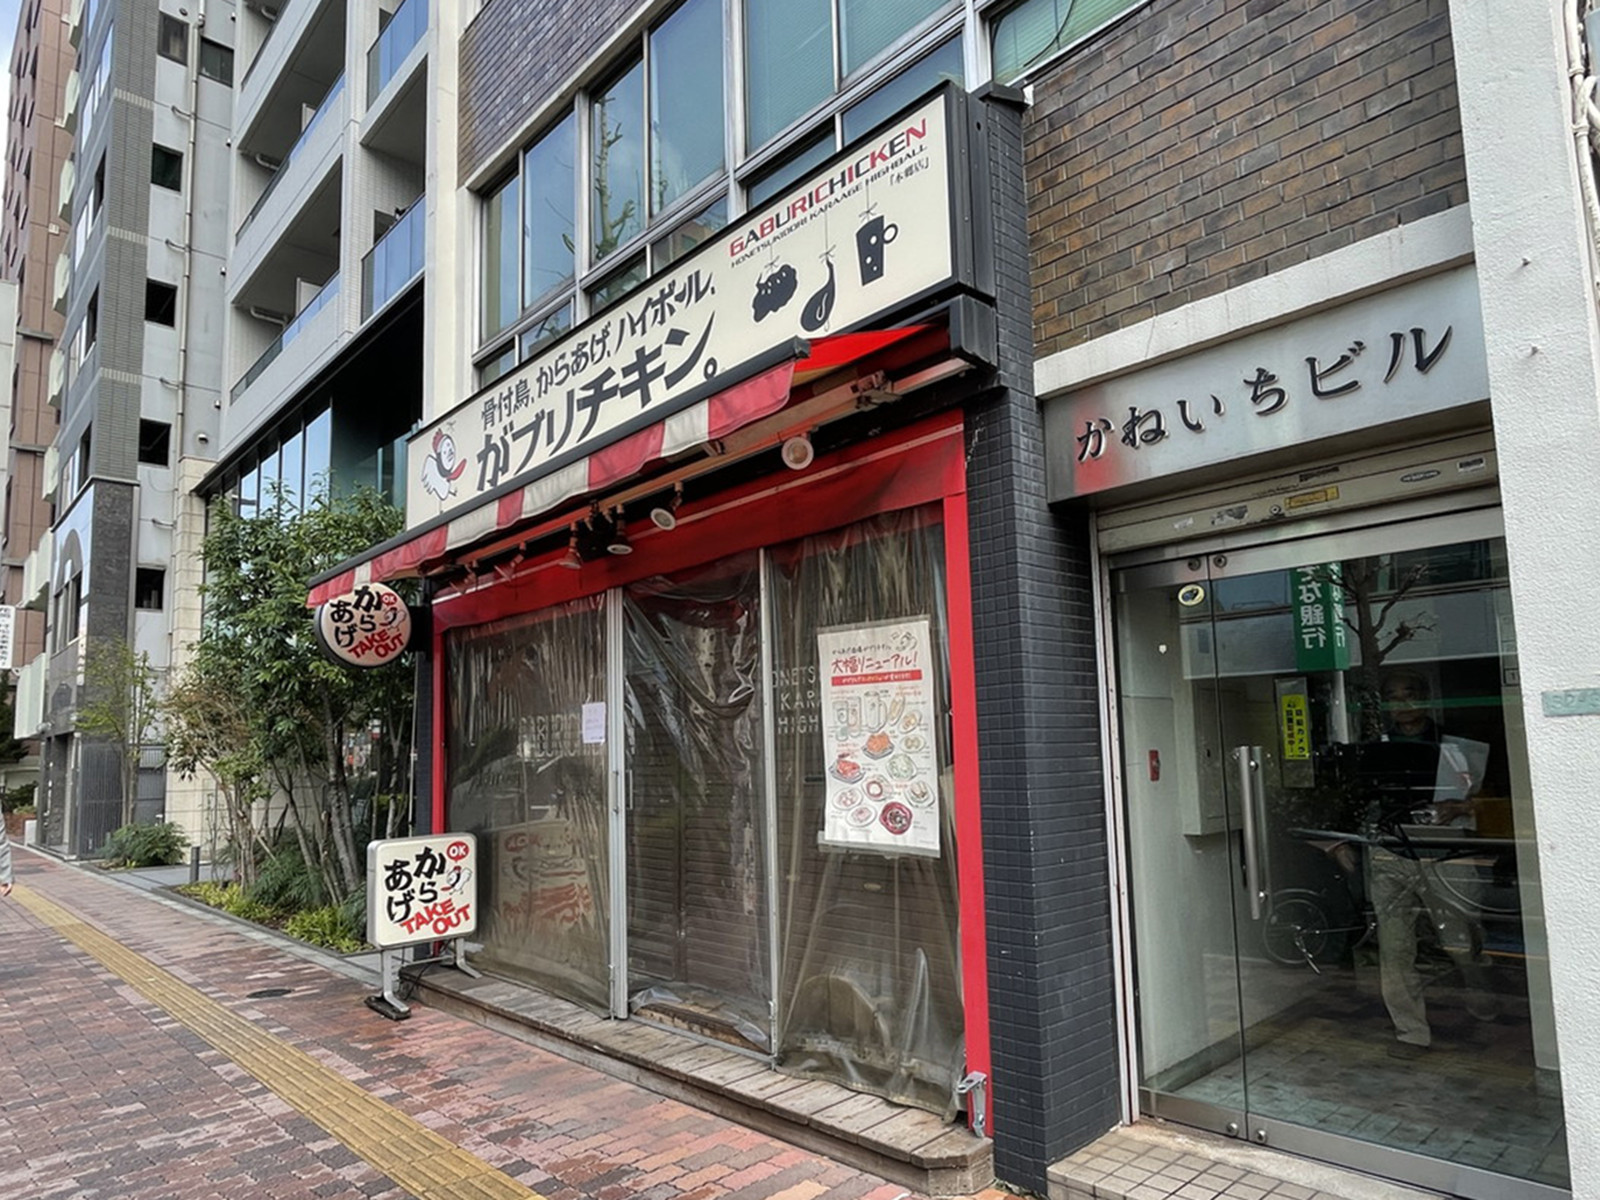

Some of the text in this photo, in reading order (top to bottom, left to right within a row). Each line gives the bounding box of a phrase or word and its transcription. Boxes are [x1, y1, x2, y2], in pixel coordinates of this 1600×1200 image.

[729, 117, 927, 257] GABURICHICKEN
[731, 143, 928, 269] HONETSUKIDORI KARAAGE HIGHBALL
[476, 310, 718, 492] がブリチキン。
[1076, 325, 1453, 462] かねいちビル
[348, 629, 391, 659] TAKE
[373, 633, 405, 659] OUT
[780, 690, 821, 711] KAR
[448, 846, 467, 858] OK
[400, 898, 456, 935] TAKE
[432, 903, 471, 935] OUT
